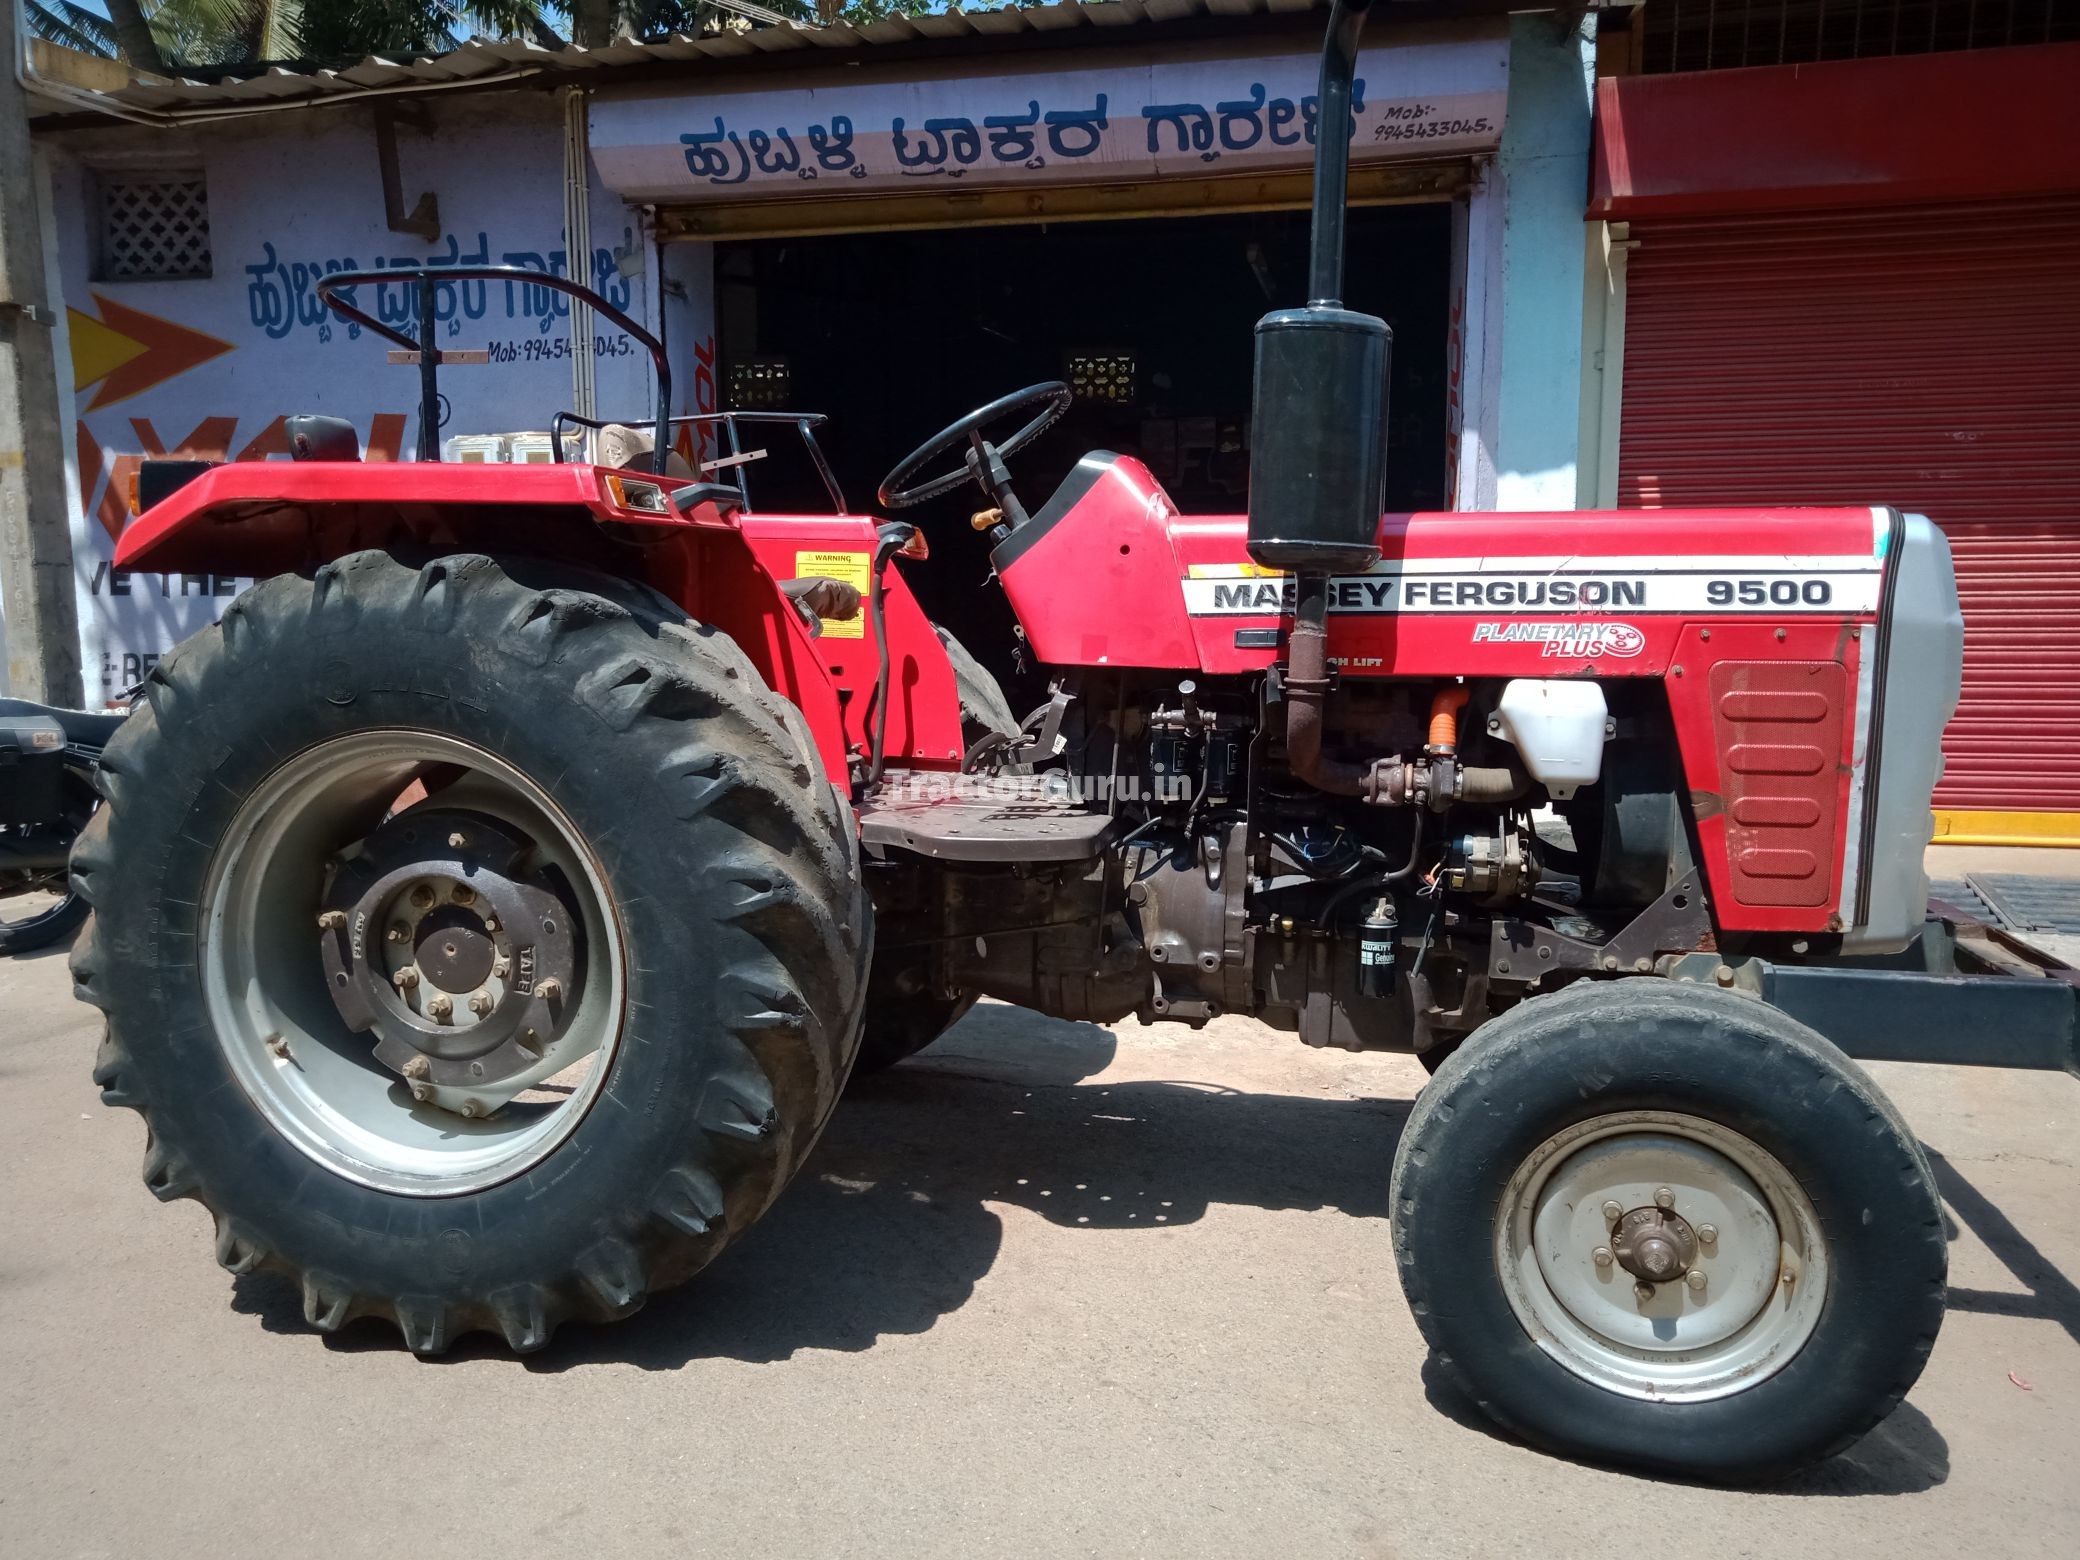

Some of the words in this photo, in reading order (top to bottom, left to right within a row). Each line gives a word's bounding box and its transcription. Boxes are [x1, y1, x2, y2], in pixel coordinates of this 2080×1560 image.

[1375, 118, 1493, 140] 9945433045.
[815, 555, 852, 563] WARNING
[1404, 580, 1646, 606] FERGUSON
[1706, 580, 1832, 606] 9500
[1472, 622, 1609, 644] PLANETARY
[1541, 639, 1605, 659] PLUS
[1353, 657, 1383, 667] LIFT
